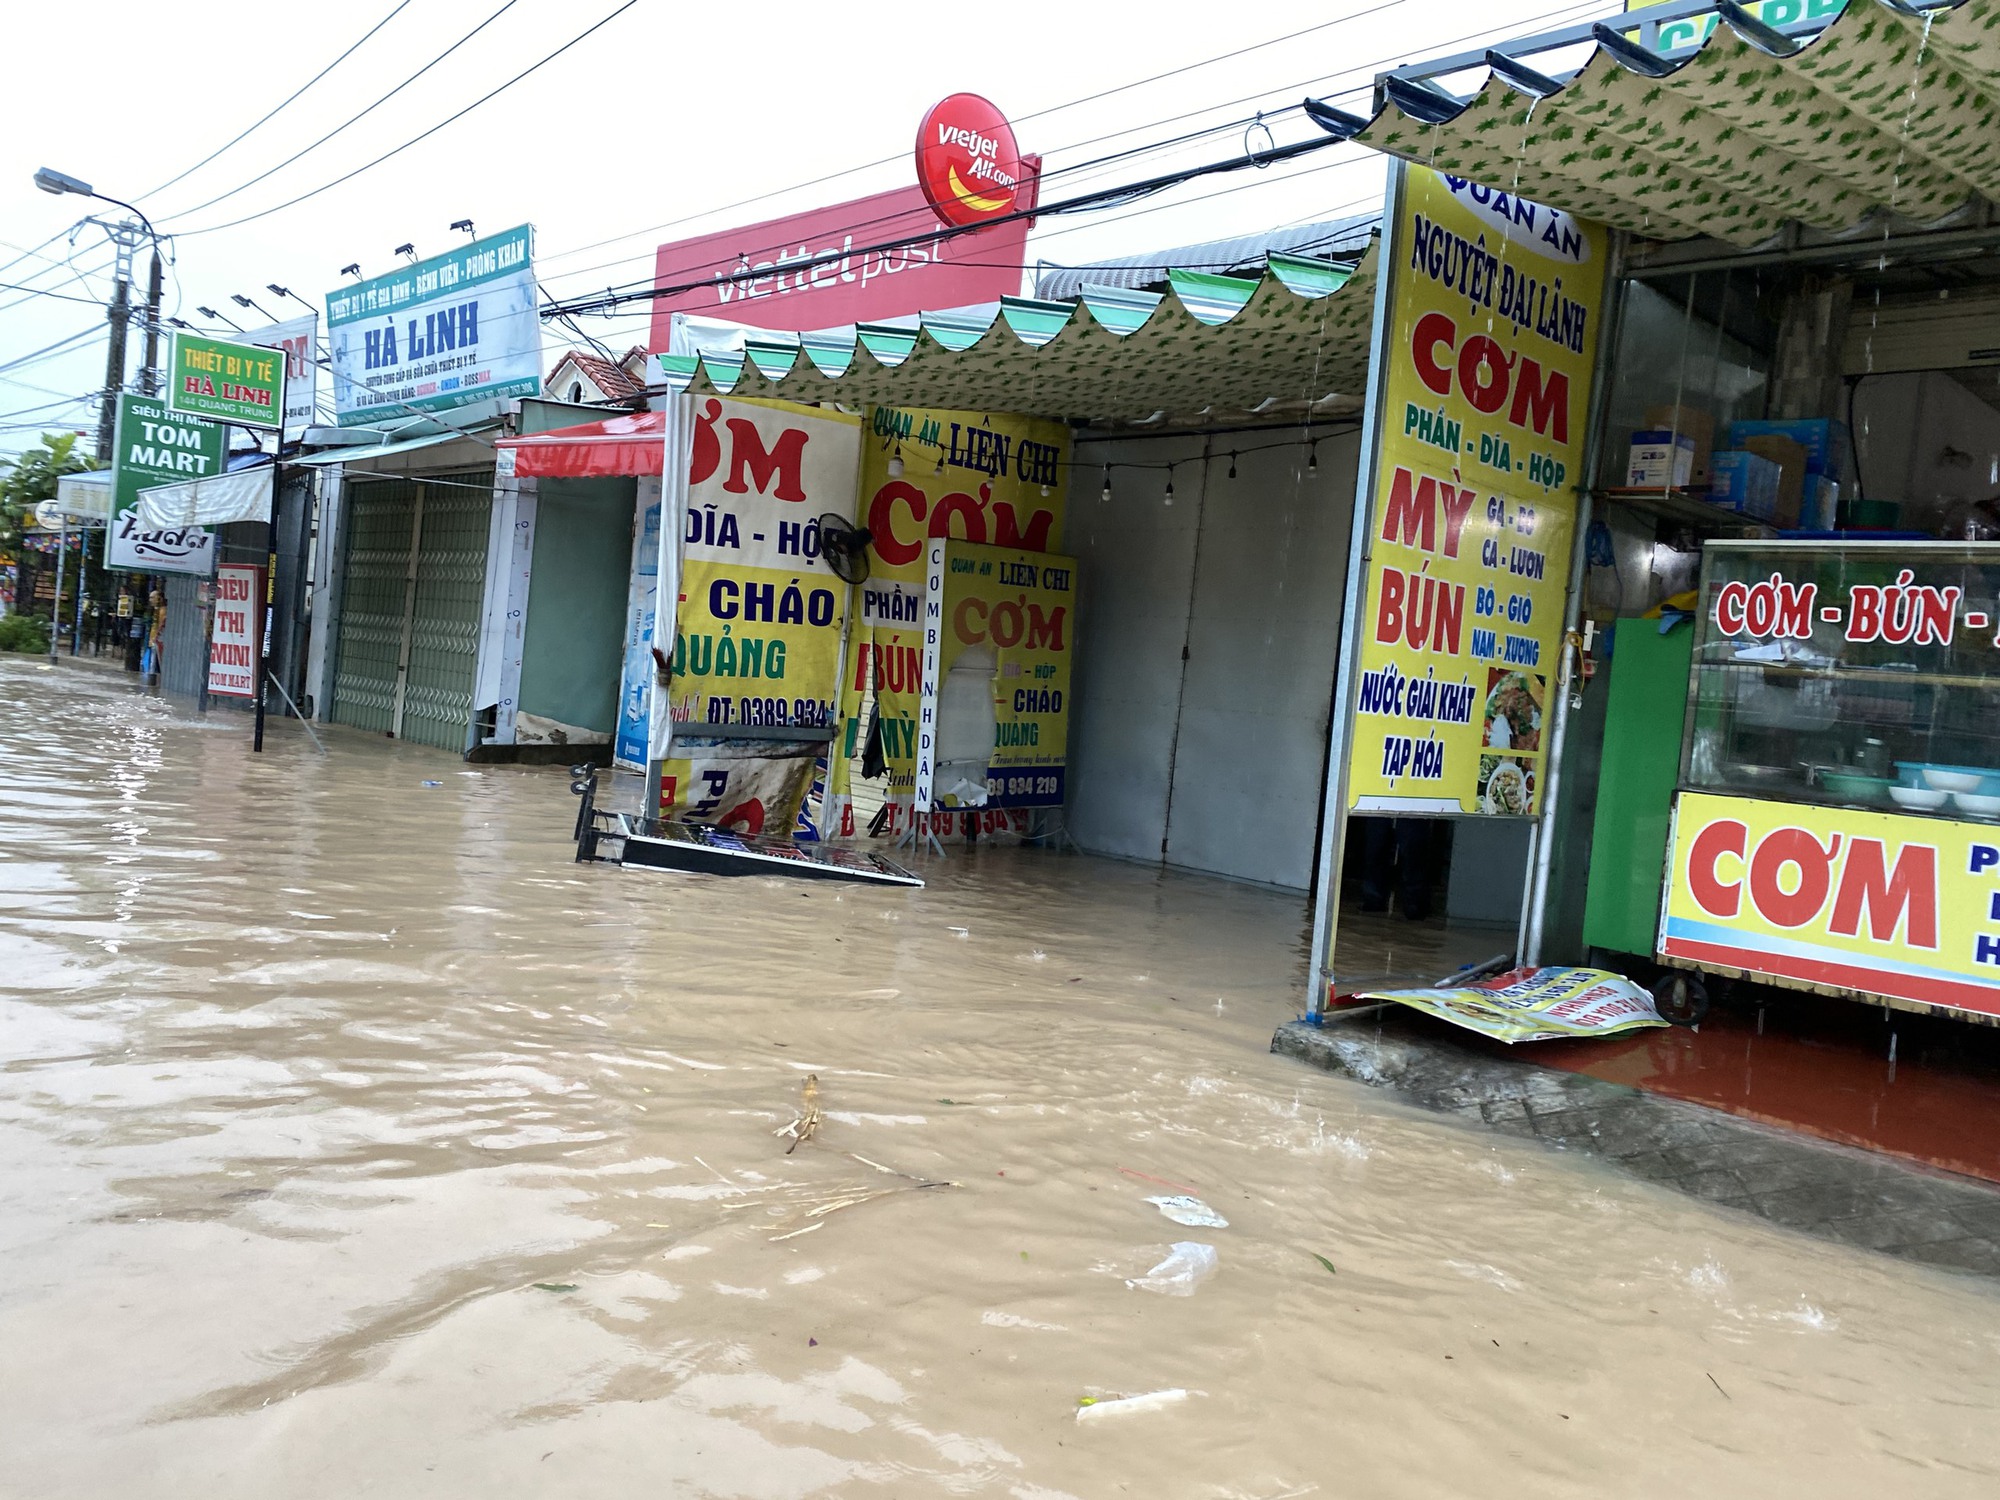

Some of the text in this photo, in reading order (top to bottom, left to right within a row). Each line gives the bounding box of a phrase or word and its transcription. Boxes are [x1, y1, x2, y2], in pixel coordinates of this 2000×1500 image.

[466, 248, 495, 280] PHÒNG
[498, 237, 525, 269] KHÁM
[715, 224, 943, 305] viettel post
[1412, 214, 1498, 316] NGUYỆT
[1499, 264, 1536, 337] ĐẠI
[271, 333, 309, 379] RT
[365, 301, 478, 370] HÀ LINH
[185, 346, 274, 382] THIẾT BỊ Y TẾ
[1412, 313, 1569, 445] CƠM
[184, 374, 272, 406] HÀ LINH
[198, 397, 236, 413] QUANG
[238, 405, 274, 419] TRUNG
[131, 404, 160, 418] SIÊU
[162, 410, 184, 425] THỊ
[141, 421, 201, 450] TOM
[129, 444, 211, 474] MART
[948, 415, 1011, 477] LIÊN
[1016, 439, 1060, 487] CHI
[1405, 403, 1461, 453] PHẦN
[1529, 451, 1565, 493] HỘP
[1382, 467, 1477, 559] MỲ
[215, 574, 249, 602] SIÊU
[999, 556, 1039, 588] LIÊN
[1043, 567, 1070, 592] CHI
[217, 610, 245, 638] THỊ
[709, 578, 835, 627] CHÁO
[864, 584, 918, 622] PHẦN
[953, 594, 1066, 651] CƠM
[1376, 560, 1465, 656] BÚN
[1717, 572, 1817, 638] CƠM
[1845, 569, 1961, 646] BÚN
[210, 642, 250, 668] MINI
[209, 672, 251, 690] TOM MART
[1013, 685, 1062, 714] CHÁO
[1359, 663, 1477, 723] NƯỚC GIẢI KHÁT
[1382, 728, 1444, 788] TẠP HÓA
[1008, 777, 1034, 795] 934
[1036, 776, 1058, 795] 219
[1688, 819, 1938, 949] CƠM
